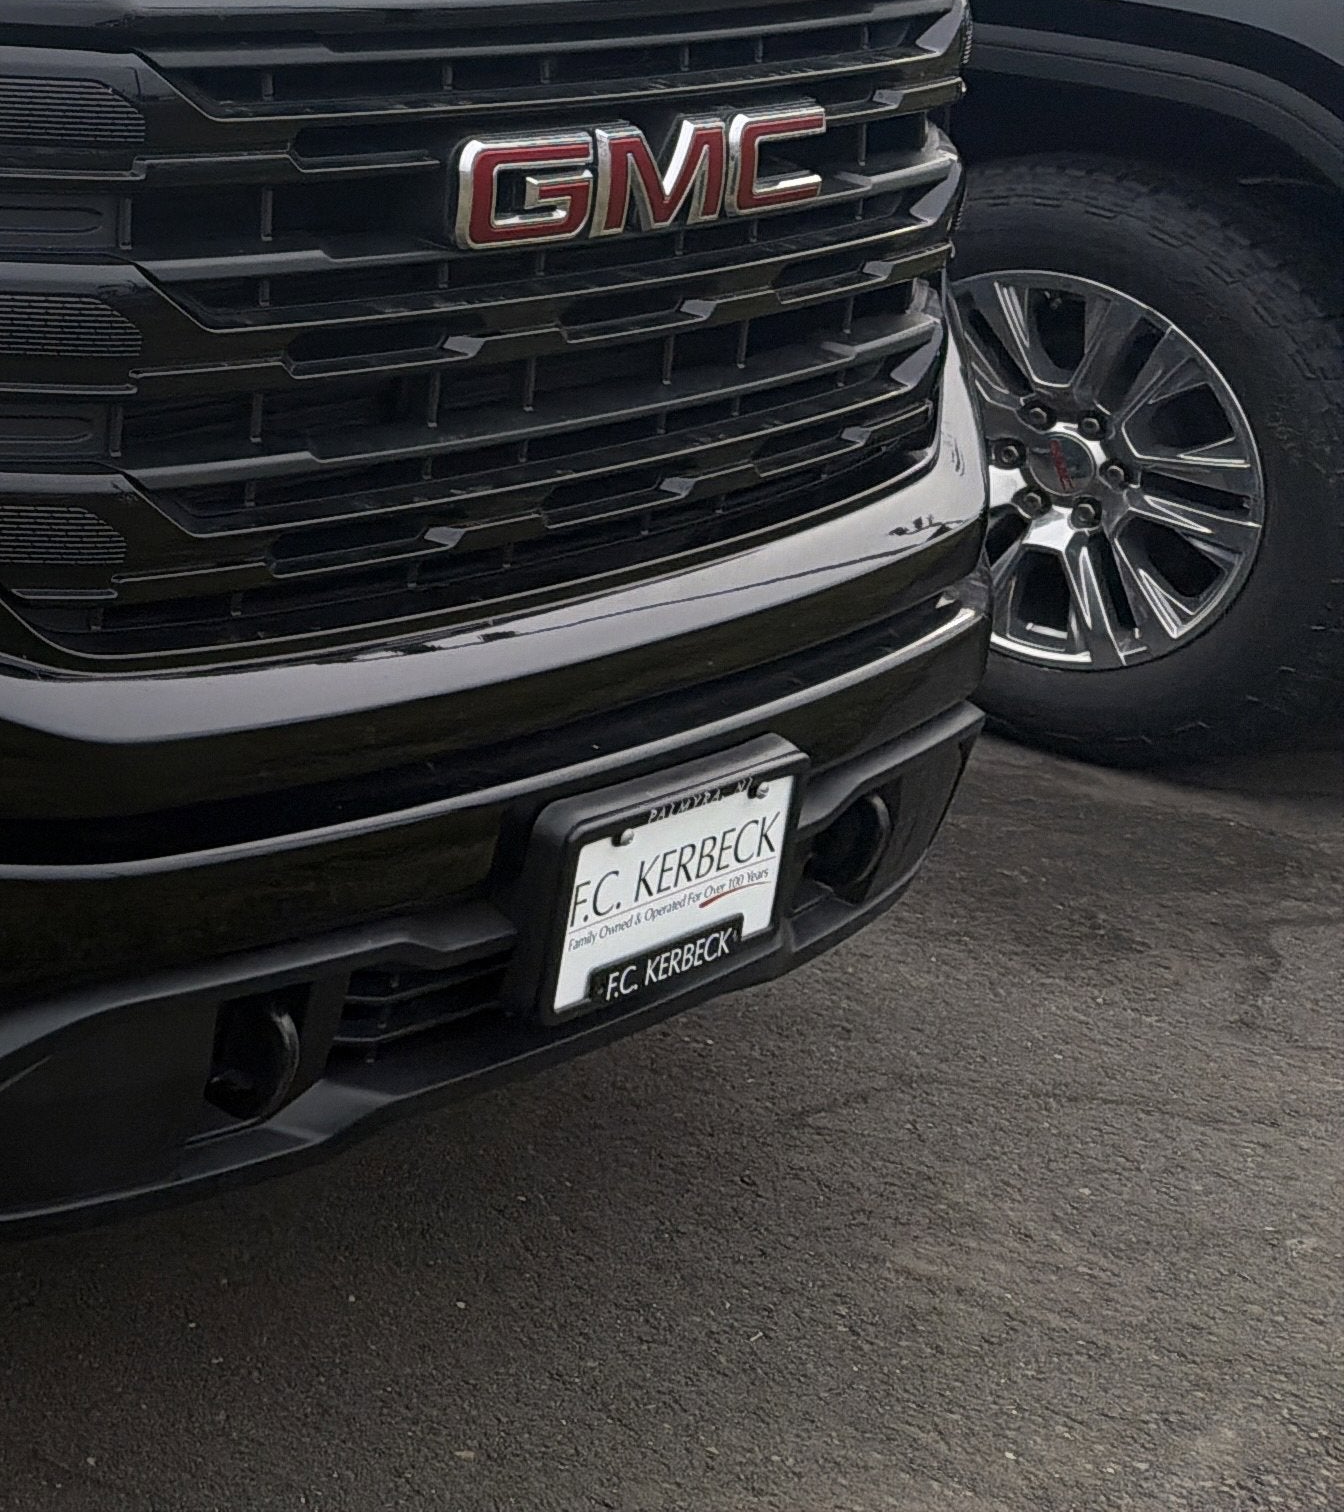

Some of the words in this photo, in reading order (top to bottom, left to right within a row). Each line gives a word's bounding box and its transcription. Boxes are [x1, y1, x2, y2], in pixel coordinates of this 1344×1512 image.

[455, 105, 827, 250] GMC
[568, 931, 598, 952] Family
[598, 915, 633, 939] Owned
[634, 912, 643, 925] &
[644, 893, 688, 922] Operated
[687, 890, 702, 906] For
[703, 882, 726, 899] Over
[728, 873, 745, 890] 100
[746, 868, 770, 883] Years
[569, 870, 621, 928] F.C.
[634, 811, 781, 903] KERBECK
[605, 965, 639, 1001] F.C.
[644, 928, 732, 986] KERBECK
